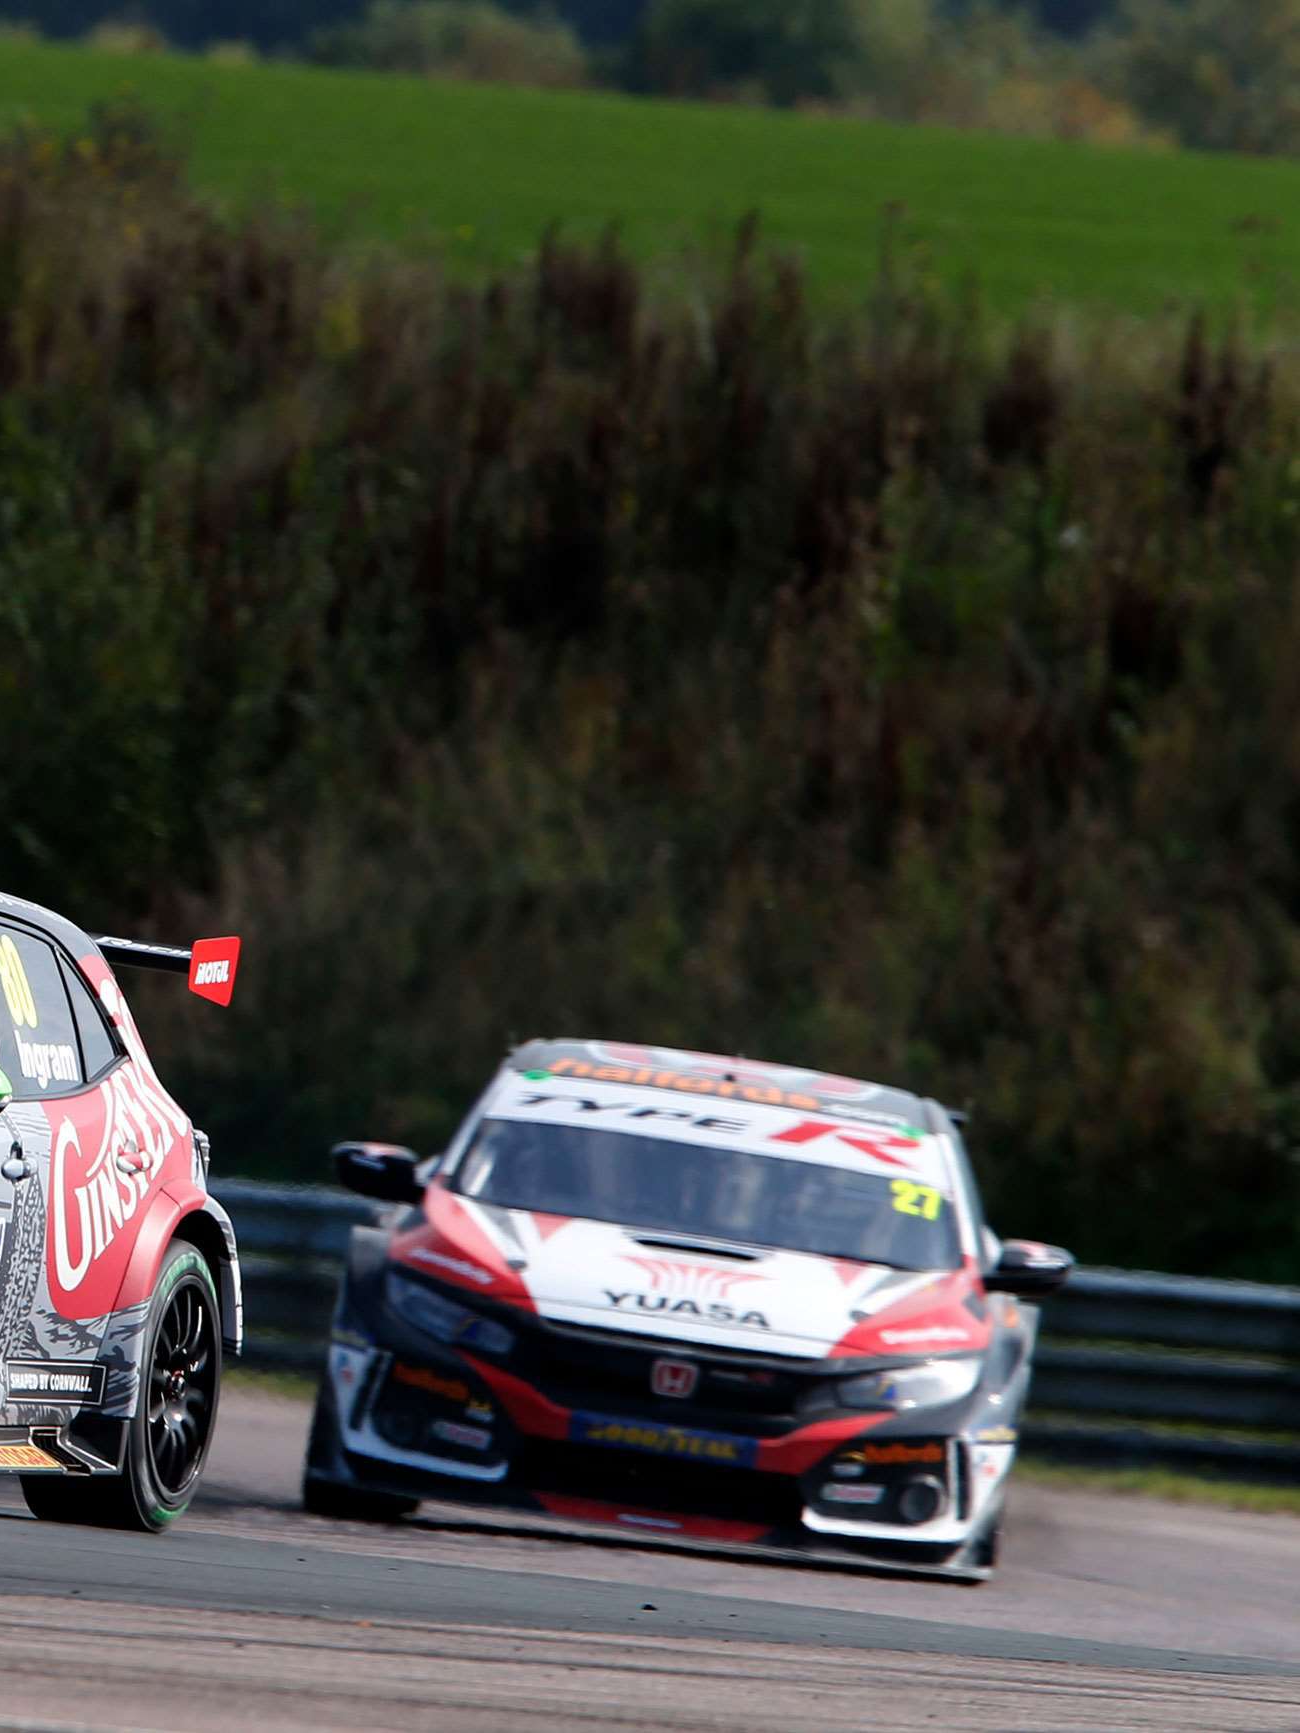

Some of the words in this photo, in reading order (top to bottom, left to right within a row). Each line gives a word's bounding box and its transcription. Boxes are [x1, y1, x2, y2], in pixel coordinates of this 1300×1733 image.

[194, 960, 230, 985] MOTUL
[13, 1029, 79, 1089] Ingram
[518, 1093, 751, 1136] TYPE
[766, 1120, 923, 1169] R
[890, 1178, 942, 1221] 27
[601, 1289, 772, 1332] YUASA
[10, 1372, 38, 1391] SHAPED
[38, 1373, 49, 1391] BY
